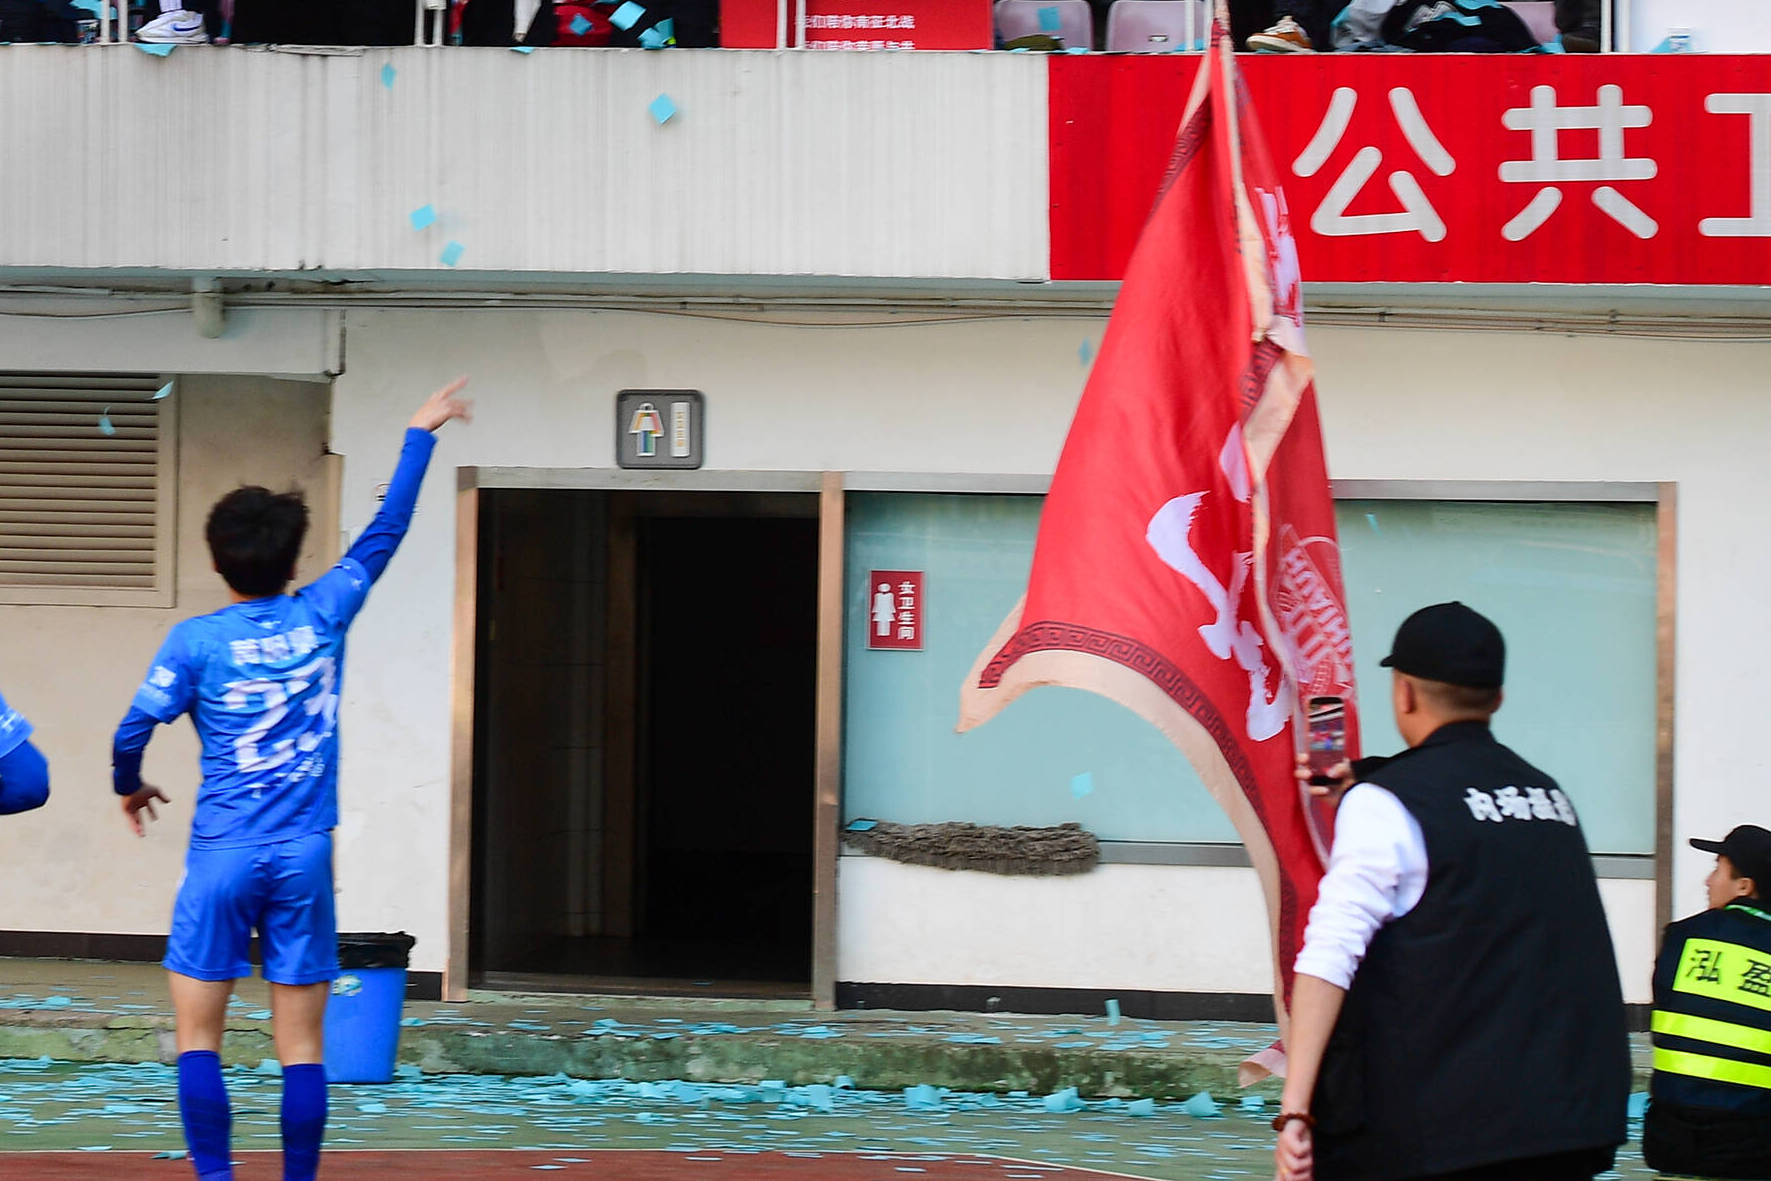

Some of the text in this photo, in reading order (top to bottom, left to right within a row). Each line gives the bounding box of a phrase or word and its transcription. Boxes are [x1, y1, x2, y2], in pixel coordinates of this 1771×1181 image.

[796, 15, 916, 29] 们陪你南征北战
